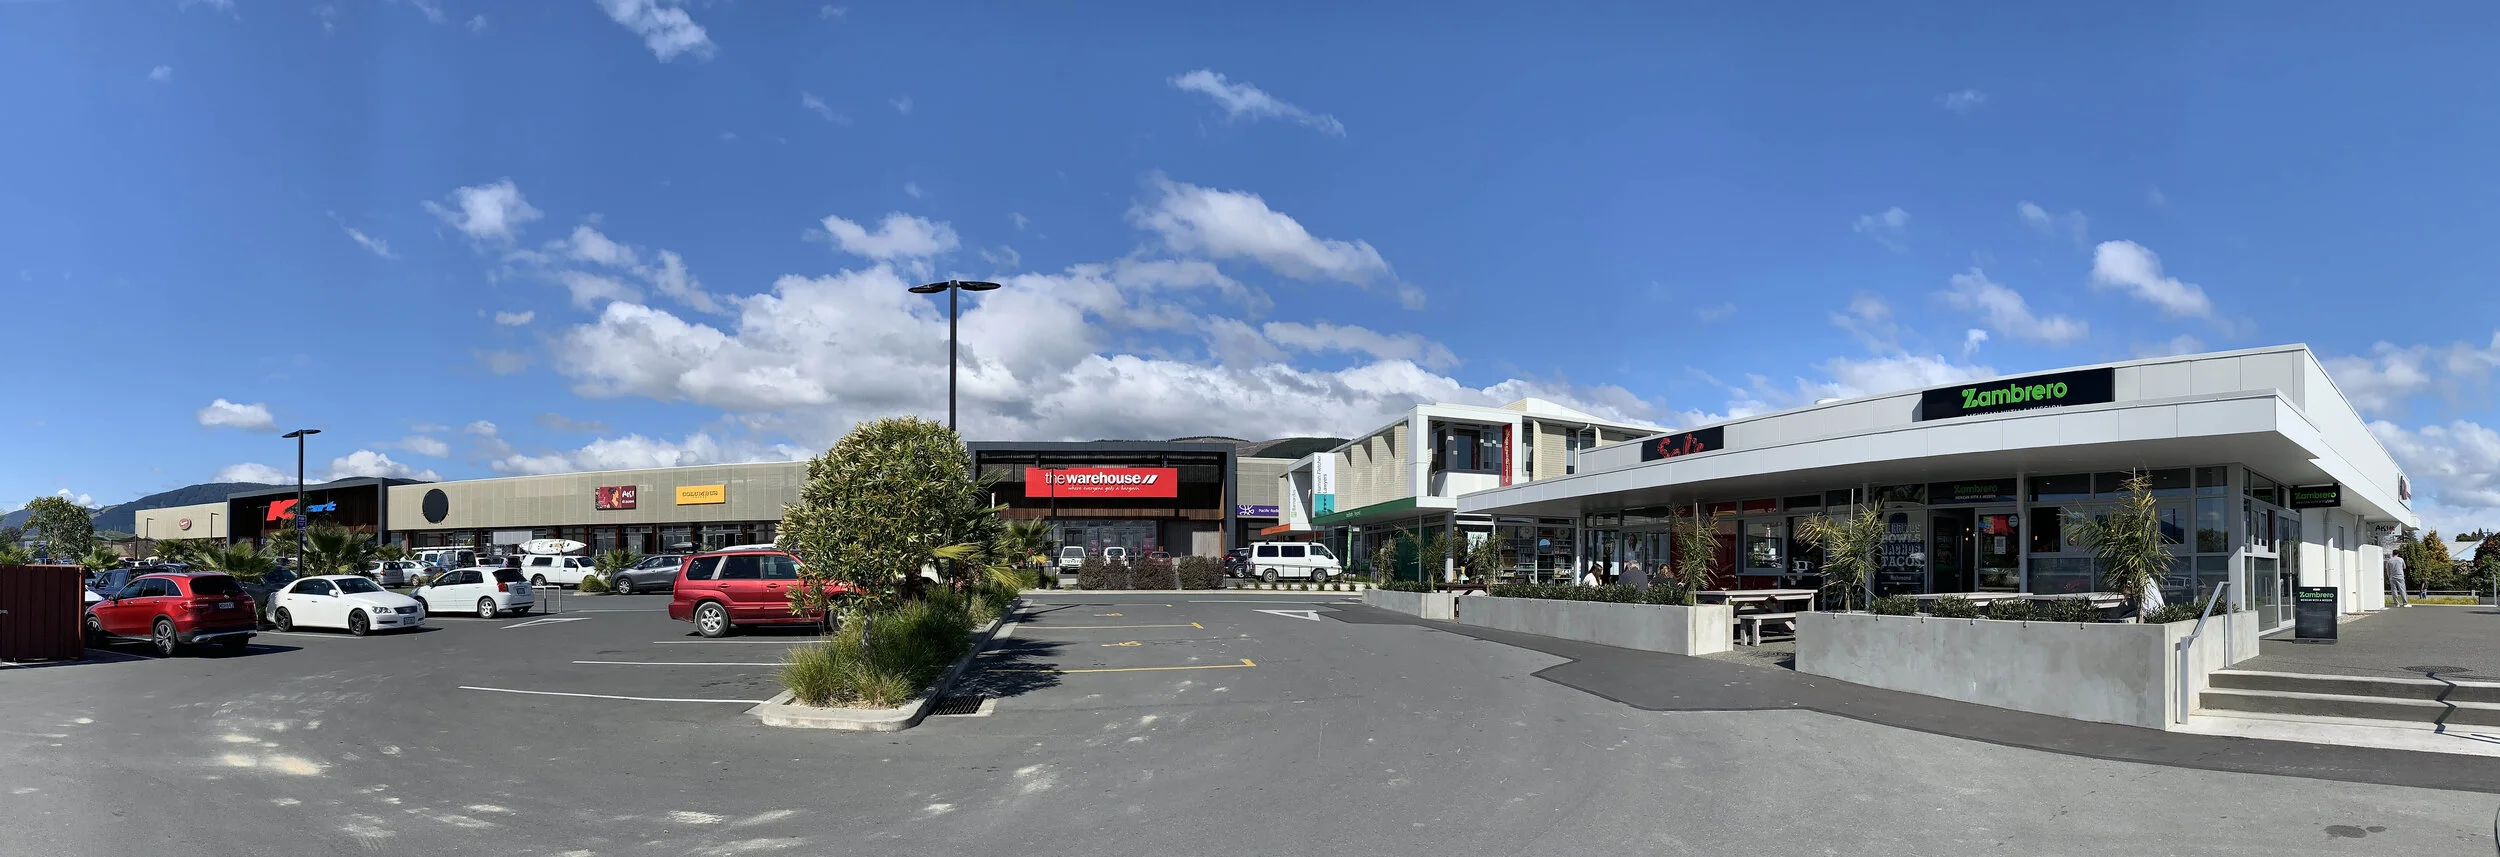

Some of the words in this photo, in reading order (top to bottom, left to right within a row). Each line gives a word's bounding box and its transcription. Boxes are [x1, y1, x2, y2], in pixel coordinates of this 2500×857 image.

[1961, 382, 2068, 409] Zambrero
[1045, 472, 1066, 485] the
[1065, 471, 1141, 485] warehouse
[1120, 484, 1140, 492] bargain
[1954, 484, 1998, 495] Zambrero
[2294, 491, 2336, 500] Zambrero
[1881, 556, 1921, 567] TACOS
